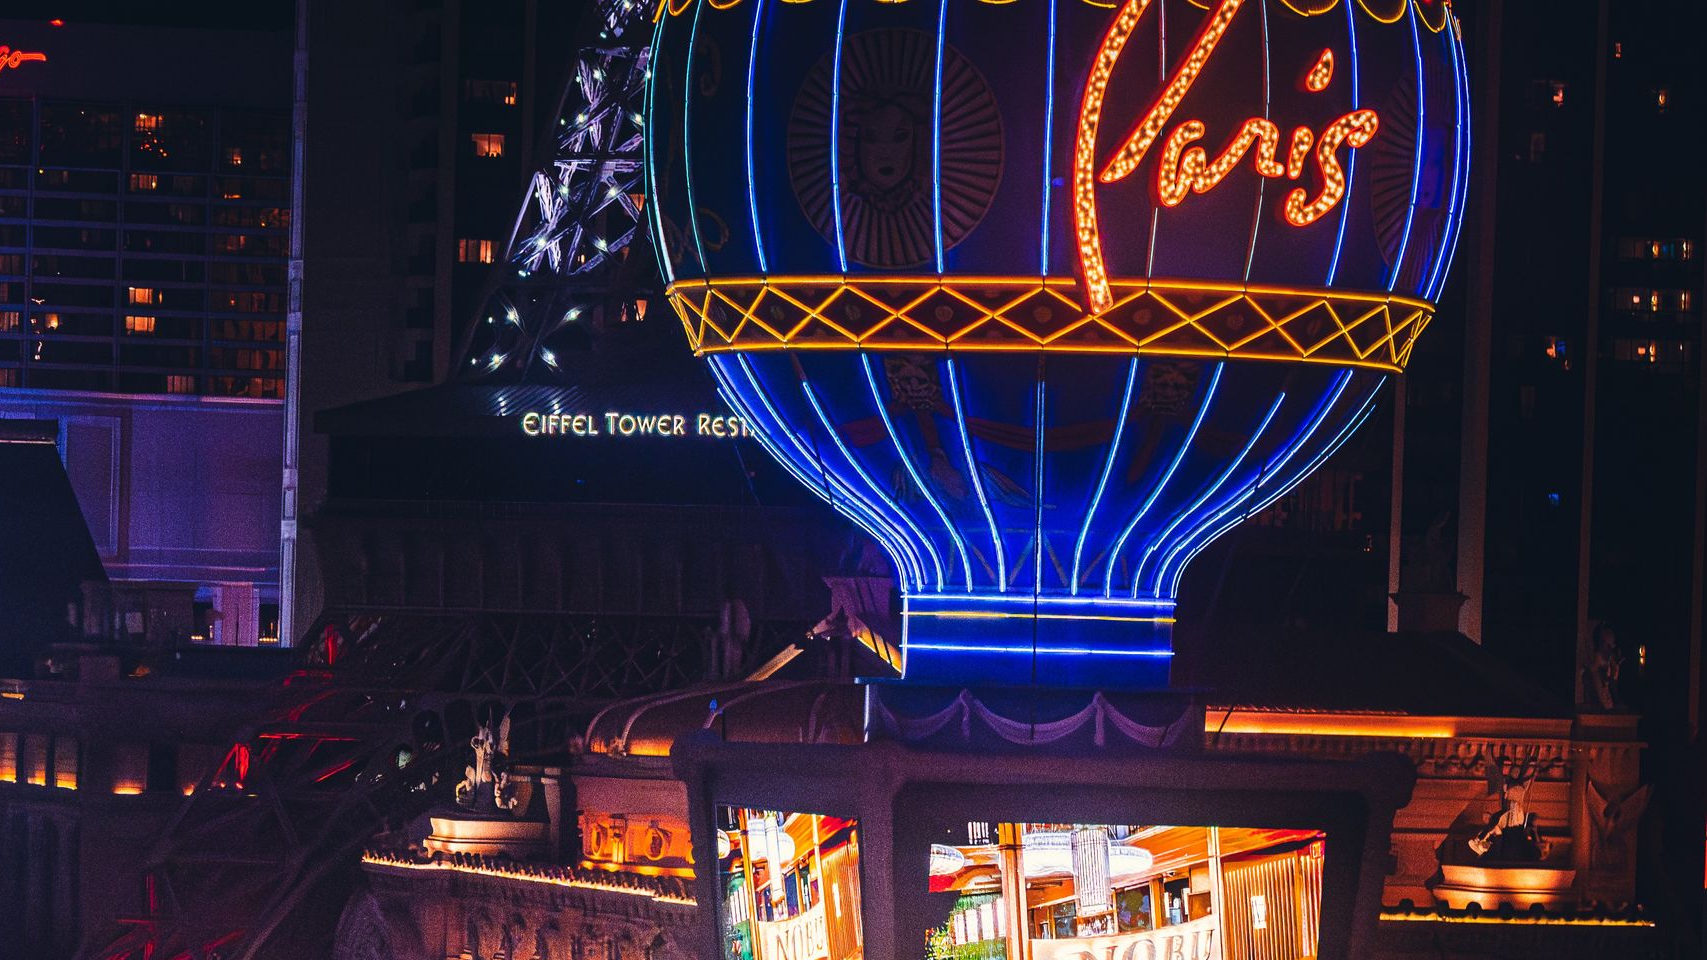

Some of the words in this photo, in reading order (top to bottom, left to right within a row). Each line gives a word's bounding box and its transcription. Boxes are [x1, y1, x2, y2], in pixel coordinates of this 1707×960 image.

[1073, 0, 1380, 314] Paris
[523, 412, 598, 436] EIFFEL
[604, 412, 686, 436] TOWER
